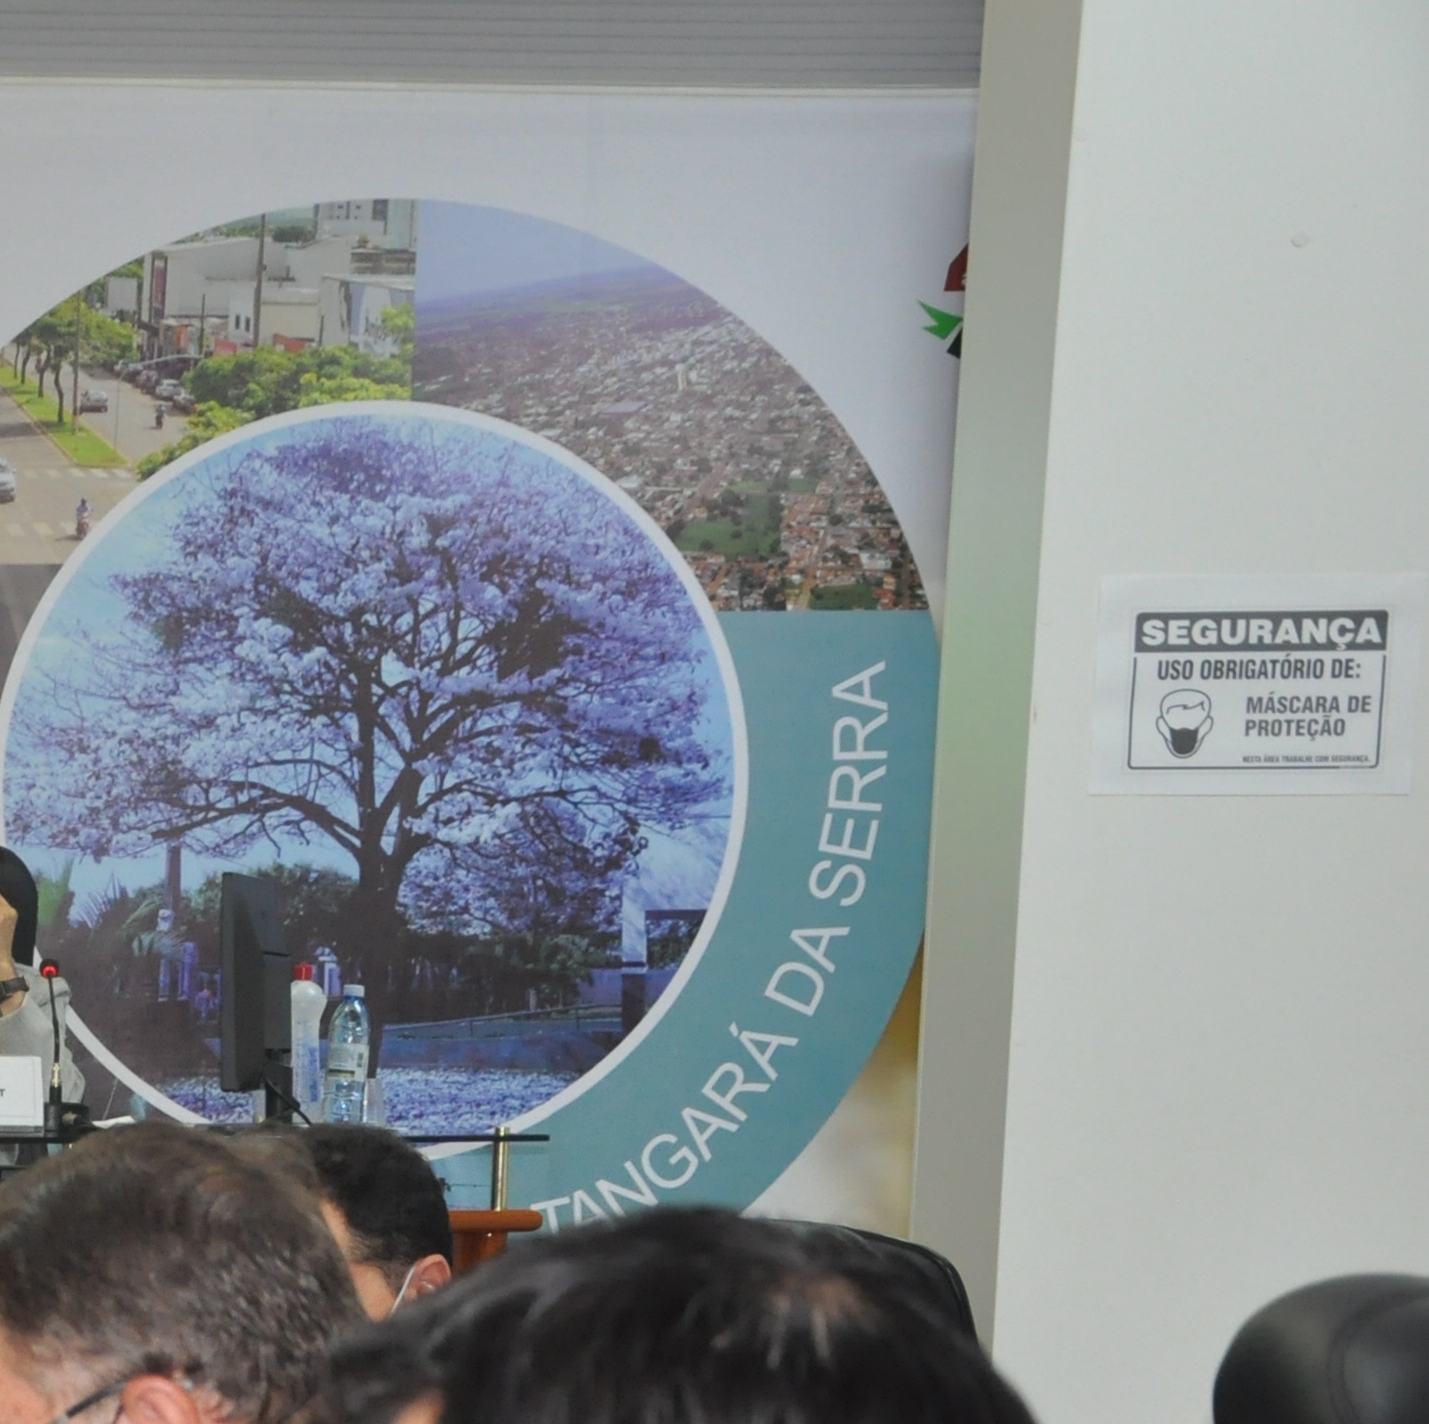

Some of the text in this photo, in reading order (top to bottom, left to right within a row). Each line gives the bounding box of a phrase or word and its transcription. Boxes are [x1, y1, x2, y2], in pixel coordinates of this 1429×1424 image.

[1140, 617, 1383, 651] SEGURANÇA
[1157, 653, 1362, 681] USO OBRIGATÓRIO DE:
[1245, 690, 1372, 715] MÁSCARA DE
[1244, 714, 1346, 742] PROTEÇÃO
[531, 660, 889, 1236] TANGARÁ DA SERRA
